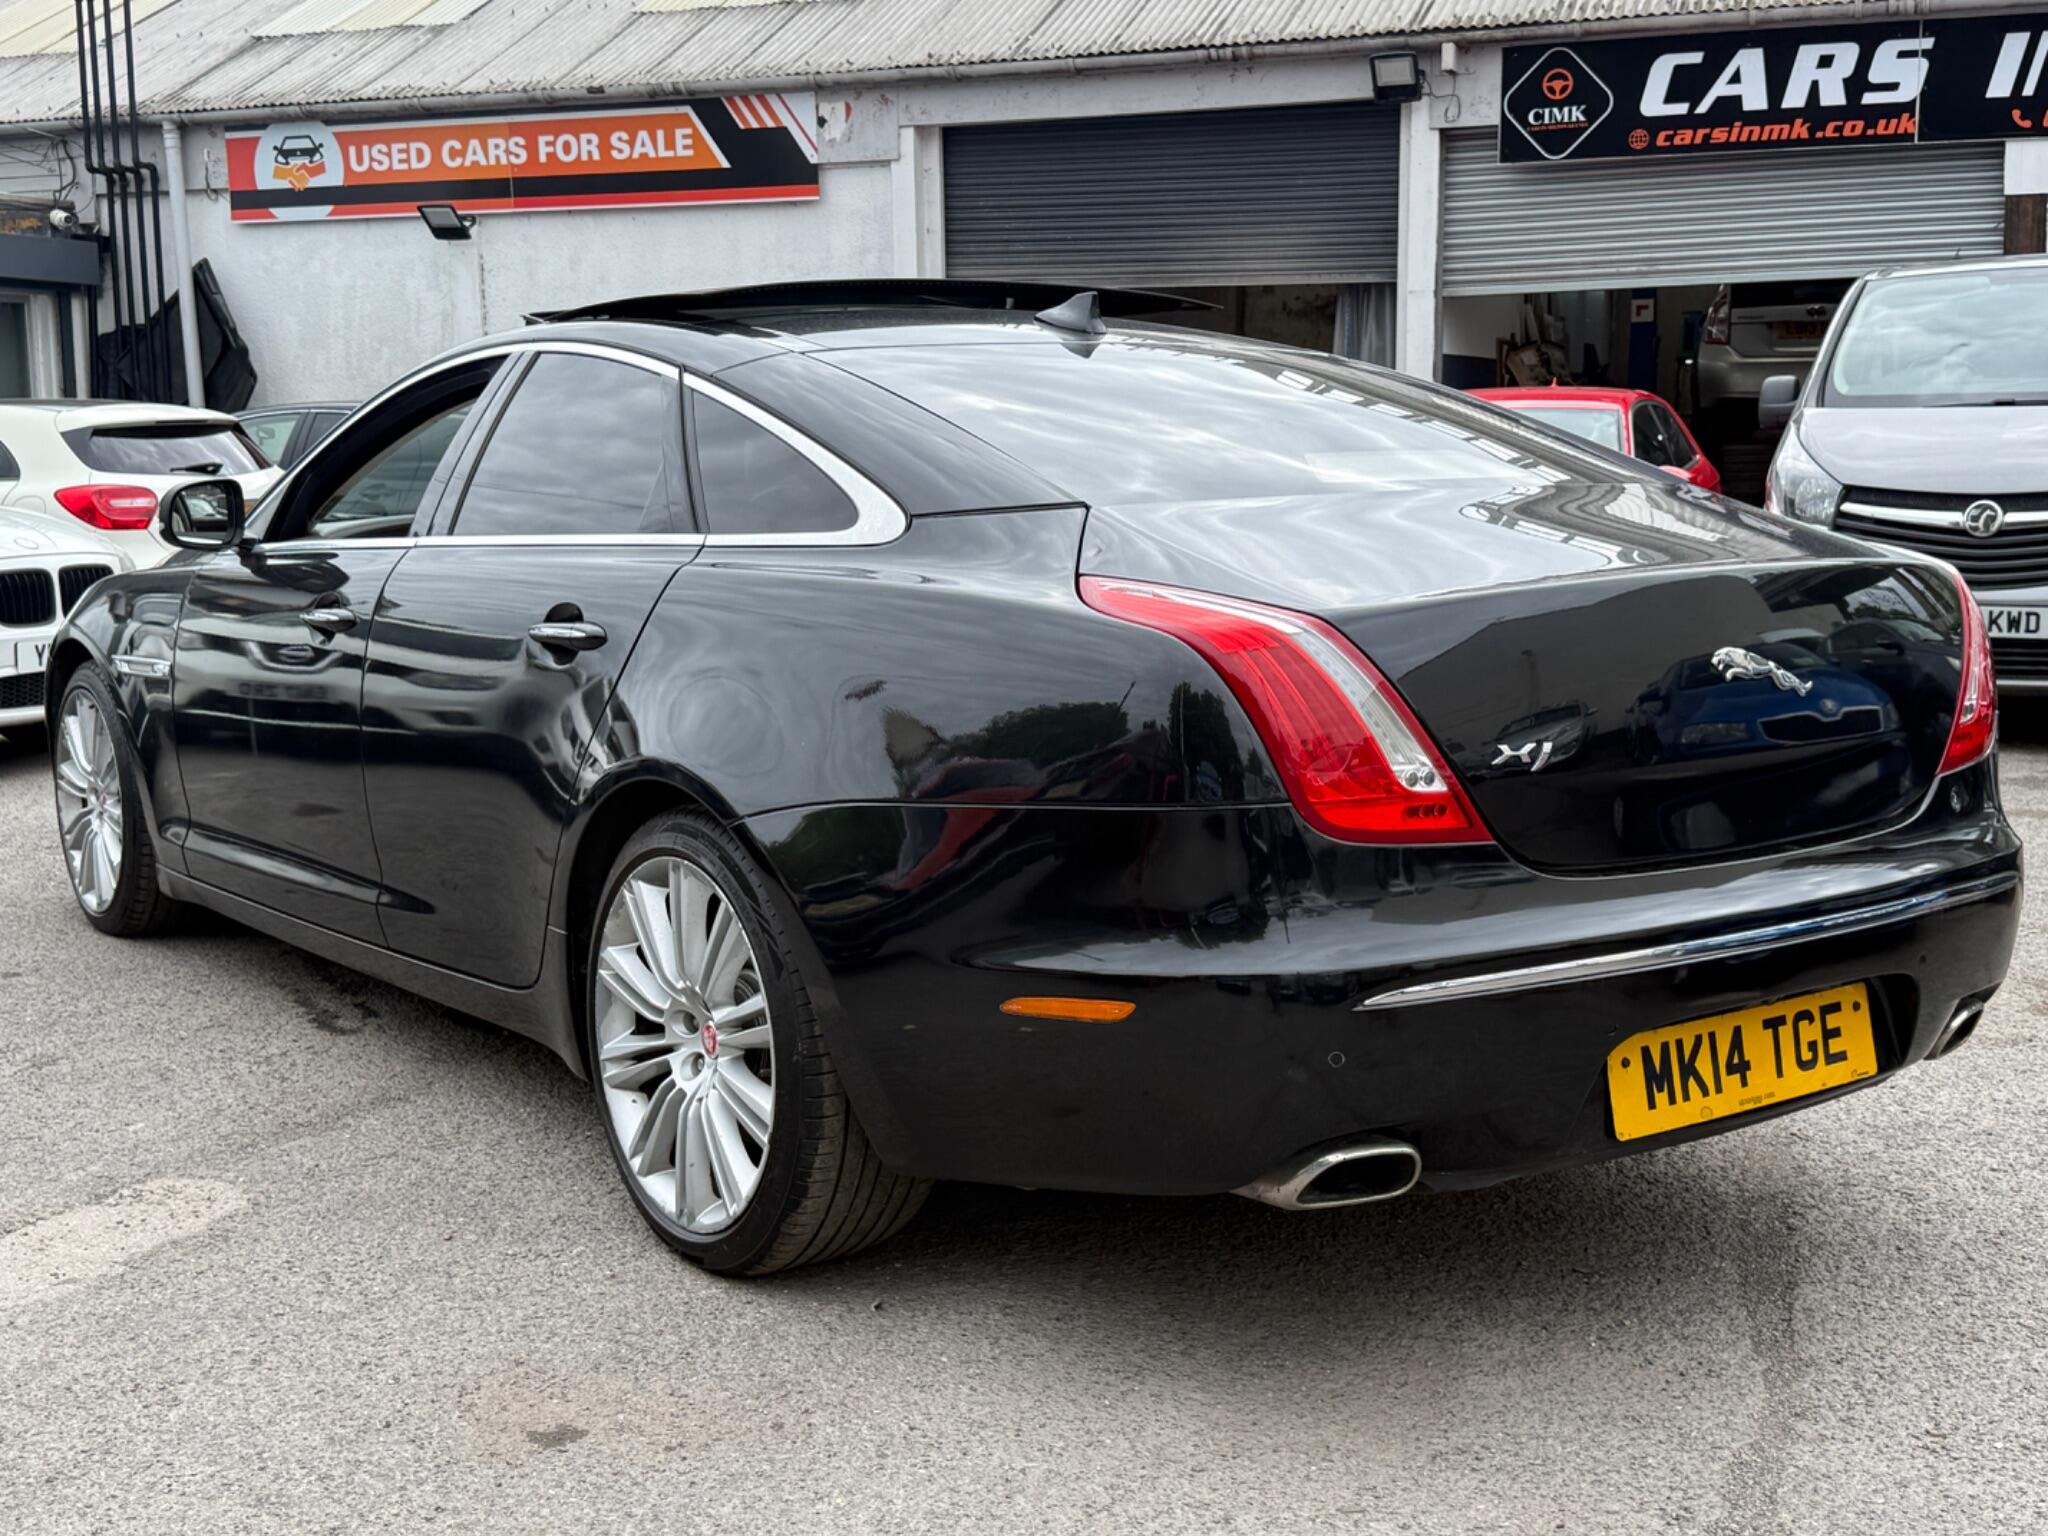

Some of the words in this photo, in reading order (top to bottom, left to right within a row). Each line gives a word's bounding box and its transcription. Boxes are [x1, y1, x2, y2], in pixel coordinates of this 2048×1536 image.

[1640, 36, 1935, 117] CARS
[1528, 105, 1587, 125] CIMK
[1655, 115, 1919, 147] carsinmk.co.uk
[349, 141, 432, 173] USED
[441, 136, 528, 169] CARS
[538, 132, 602, 163] FOR
[610, 127, 695, 159] SALE
[1988, 609, 2041, 634] KWD
[1491, 741, 1552, 772] XJ
[1640, 1024, 1751, 1111] MK14
[1762, 1001, 1848, 1079] TGE
